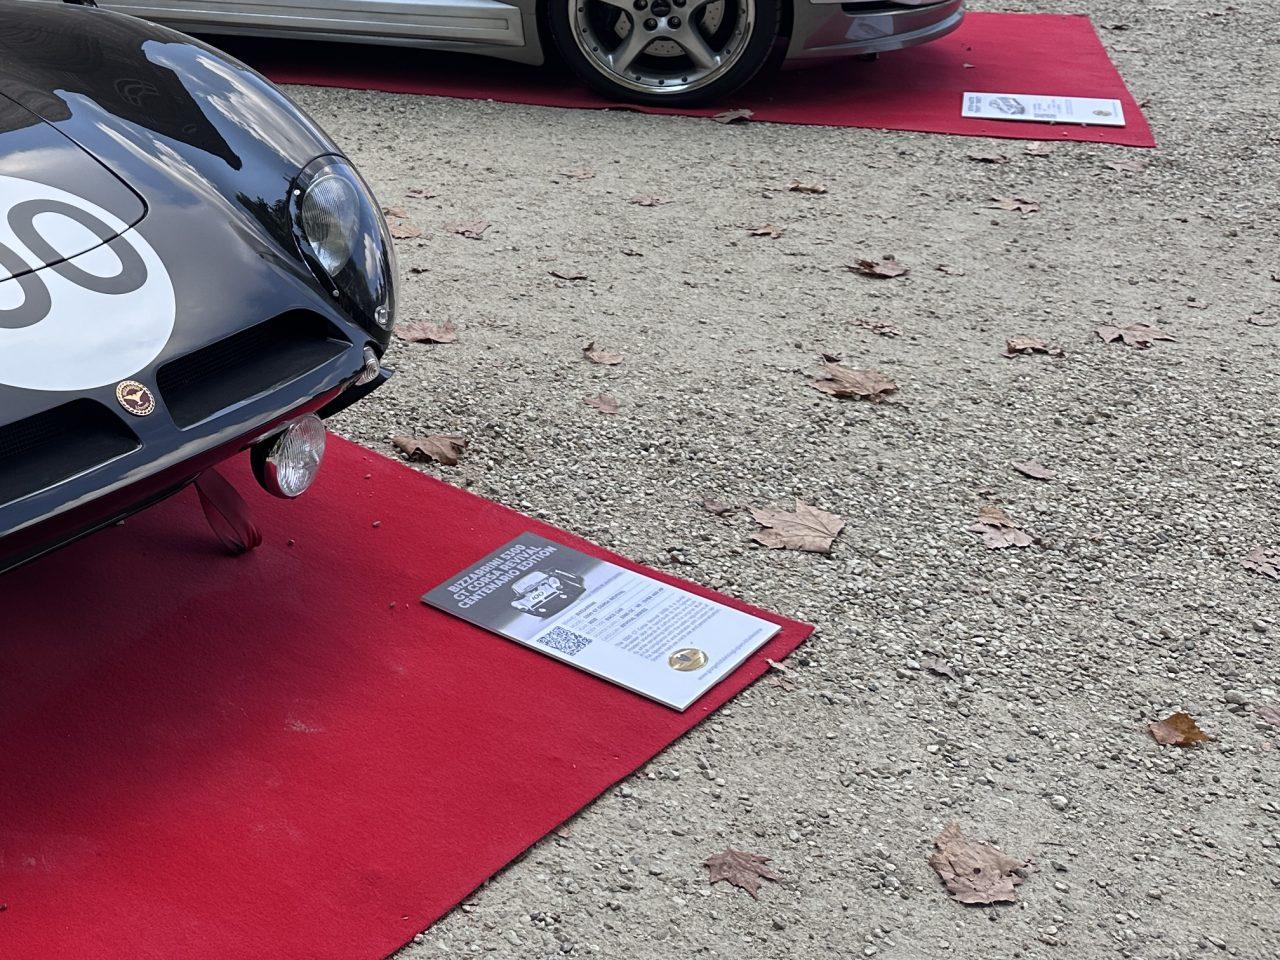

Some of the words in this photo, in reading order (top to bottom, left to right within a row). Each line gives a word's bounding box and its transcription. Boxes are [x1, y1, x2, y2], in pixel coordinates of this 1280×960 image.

[447, 557, 503, 593] BIZZARRINI
[500, 544, 526, 563] 5300
[453, 589, 470, 600] GT
[467, 569, 503, 592] CORSA
[500, 546, 542, 572] REVIVAL
[458, 569, 520, 608] CENTENARIO
[516, 545, 558, 571] EDITION
